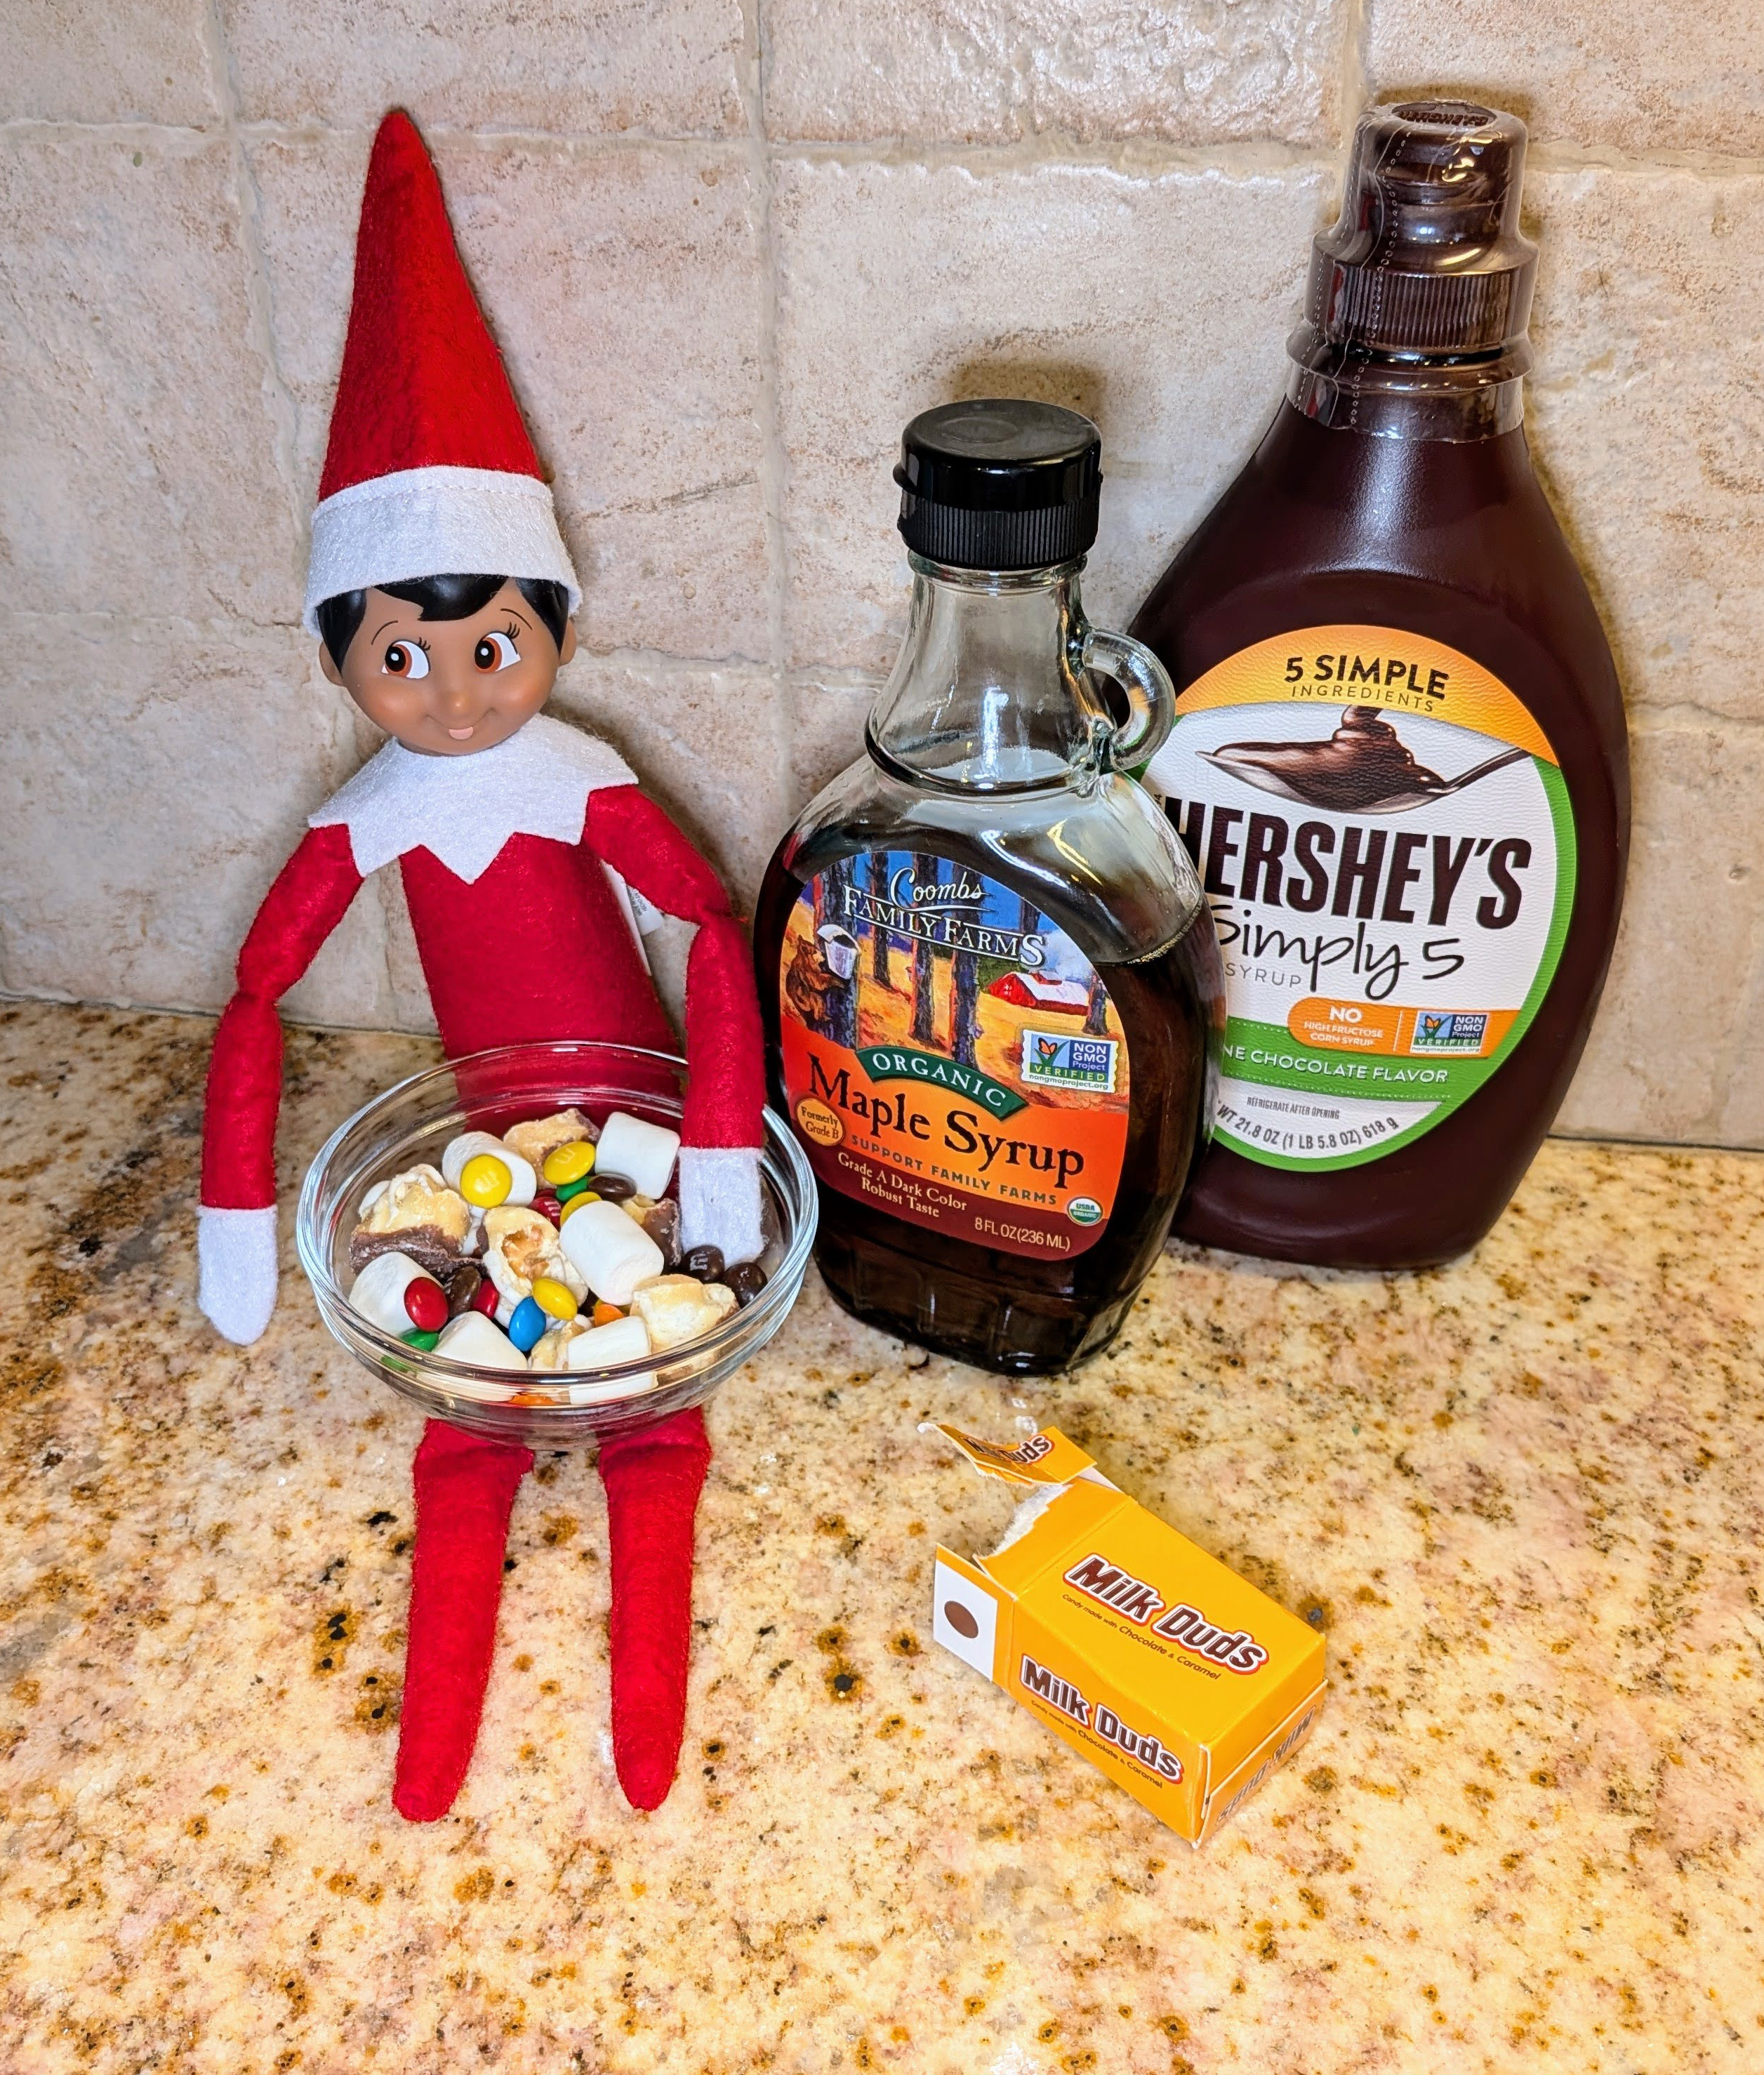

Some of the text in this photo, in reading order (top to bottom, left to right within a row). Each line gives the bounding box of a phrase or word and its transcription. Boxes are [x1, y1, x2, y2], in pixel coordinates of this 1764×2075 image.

[1284, 654, 1450, 701] 5 SIMPLE
[1291, 684, 1433, 712] INGREDIENTS
[890, 867, 990, 911] Coombs
[843, 884, 1046, 966] FAMILY FARMS
[1209, 904, 1464, 1000] Simply 5
[1224, 962, 1301, 988] SYRUP
[1304, 1021, 1384, 1038] HIGH FRUCTOSE
[1329, 1005, 1362, 1023] NO
[1455, 1016, 1484, 1024] NON
[1074, 1042, 1107, 1054] NON
[1310, 1032, 1374, 1046] CORN SYRUP
[1035, 1065, 1105, 1081] VERIFIED
[1073, 1052, 1107, 1063] GMO
[1073, 1061, 1106, 1071] Project
[1251, 1050, 1368, 1079] CHOCOLATE
[1372, 1067, 1448, 1083] FLAVOR
[873, 1053, 1007, 1107] ORGANIC
[1029, 1074, 1109, 1090] nongmoproject.org
[800, 1106, 838, 1129] Formerly
[807, 1052, 1085, 1189] Maple Syrup
[1247, 1096, 1341, 1120] REFRIGERATE AFTER OPENING
[805, 1121, 839, 1139] Grade B
[1216, 1104, 1400, 1151] WT 21.8 OZ (1 LB 5.8 OZ) 618 g
[838, 1152, 967, 1211] Grade A Dark Color
[851, 1134, 1056, 1205] SUPPORT FAMILY FARMS
[861, 1176, 939, 1218] Robust Taste
[974, 1217, 983, 1231] 8
[984, 1220, 998, 1235] FL
[1046, 1233, 1070, 1252] ML)
[997, 1436, 1052, 1464] Duds
[1066, 1555, 1266, 1671] Milk Duds
[1062, 1593, 1083, 1609] Candy
[1083, 1606, 1103, 1619] made
[1103, 1617, 1118, 1629] with
[1119, 1625, 1168, 1655] Chocolate
[1176, 1655, 1222, 1680] Caramel
[1022, 1657, 1181, 1779] Milk Duds
[1077, 1730, 1118, 1760] Chocolate
[1127, 1761, 1163, 1789] Caramel
